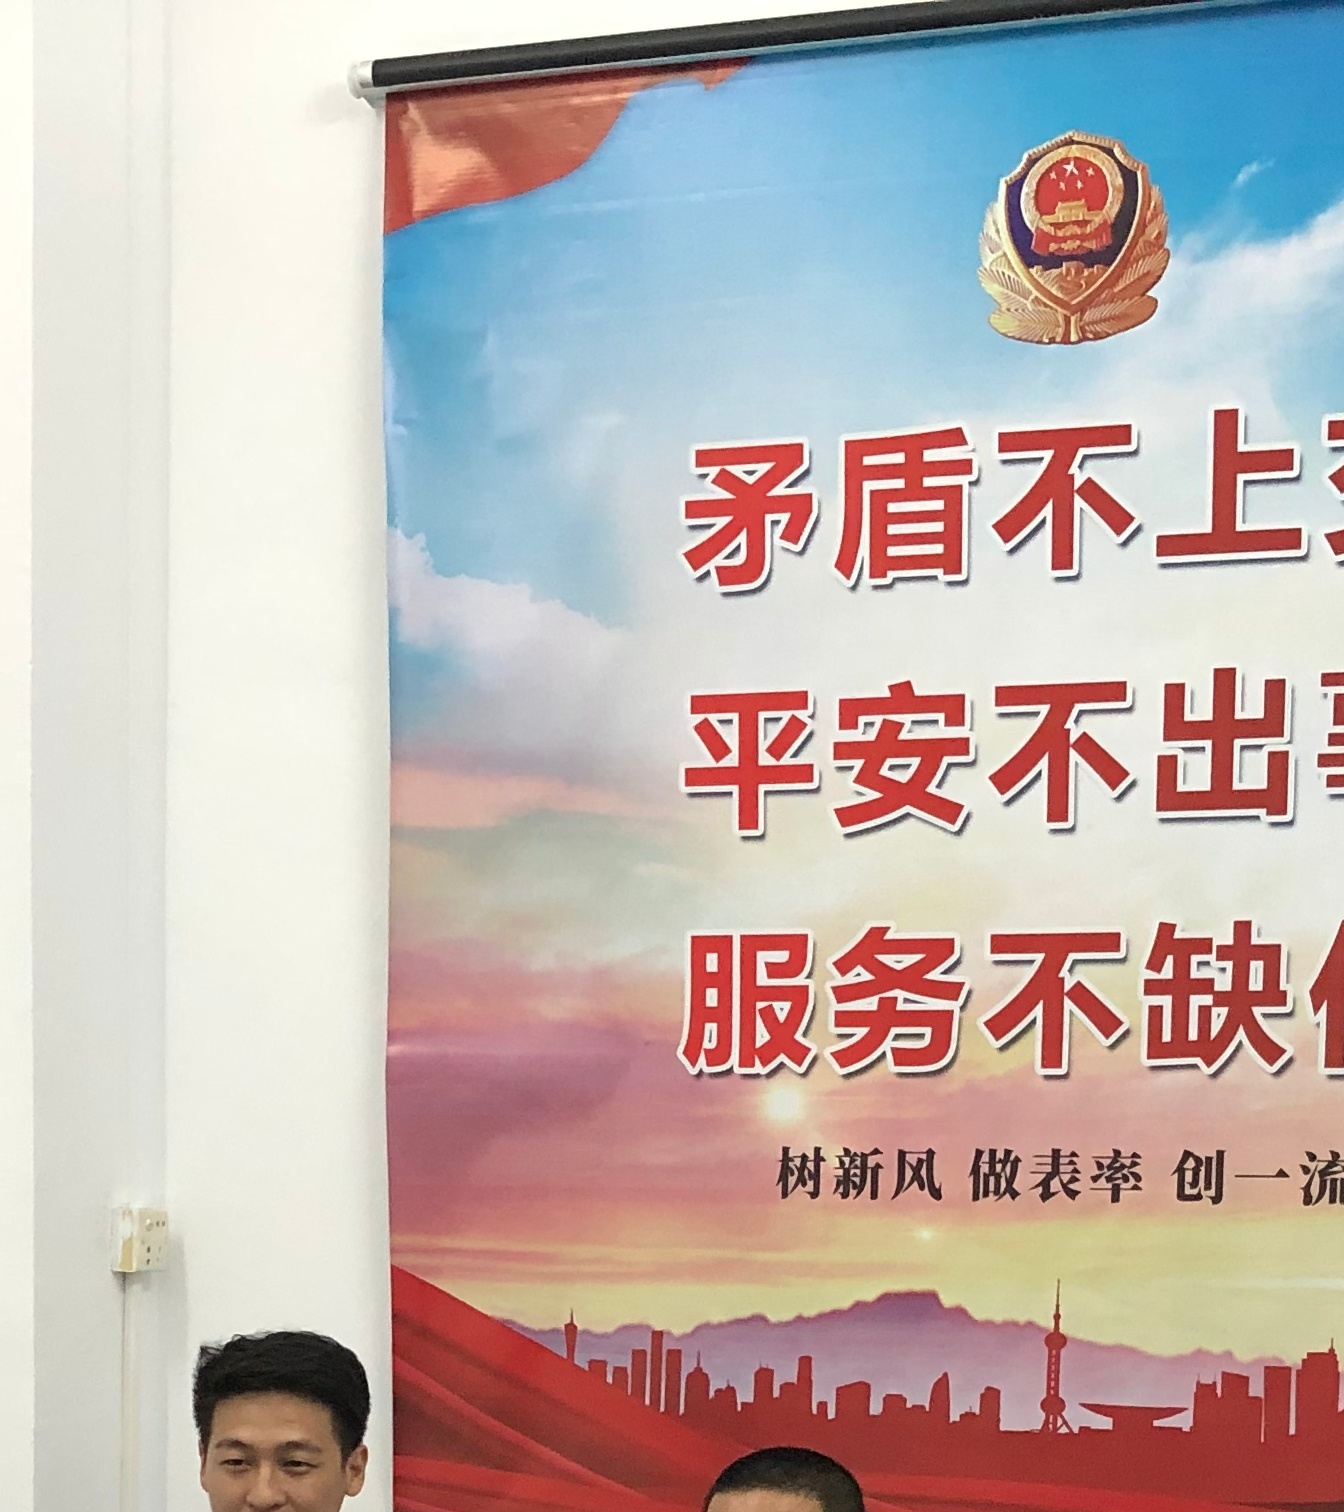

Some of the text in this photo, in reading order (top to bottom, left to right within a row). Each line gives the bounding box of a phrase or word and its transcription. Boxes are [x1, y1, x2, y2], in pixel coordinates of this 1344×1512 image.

[777, 1144, 944, 1204] 树新风
[968, 1146, 1144, 1206] 做表率
